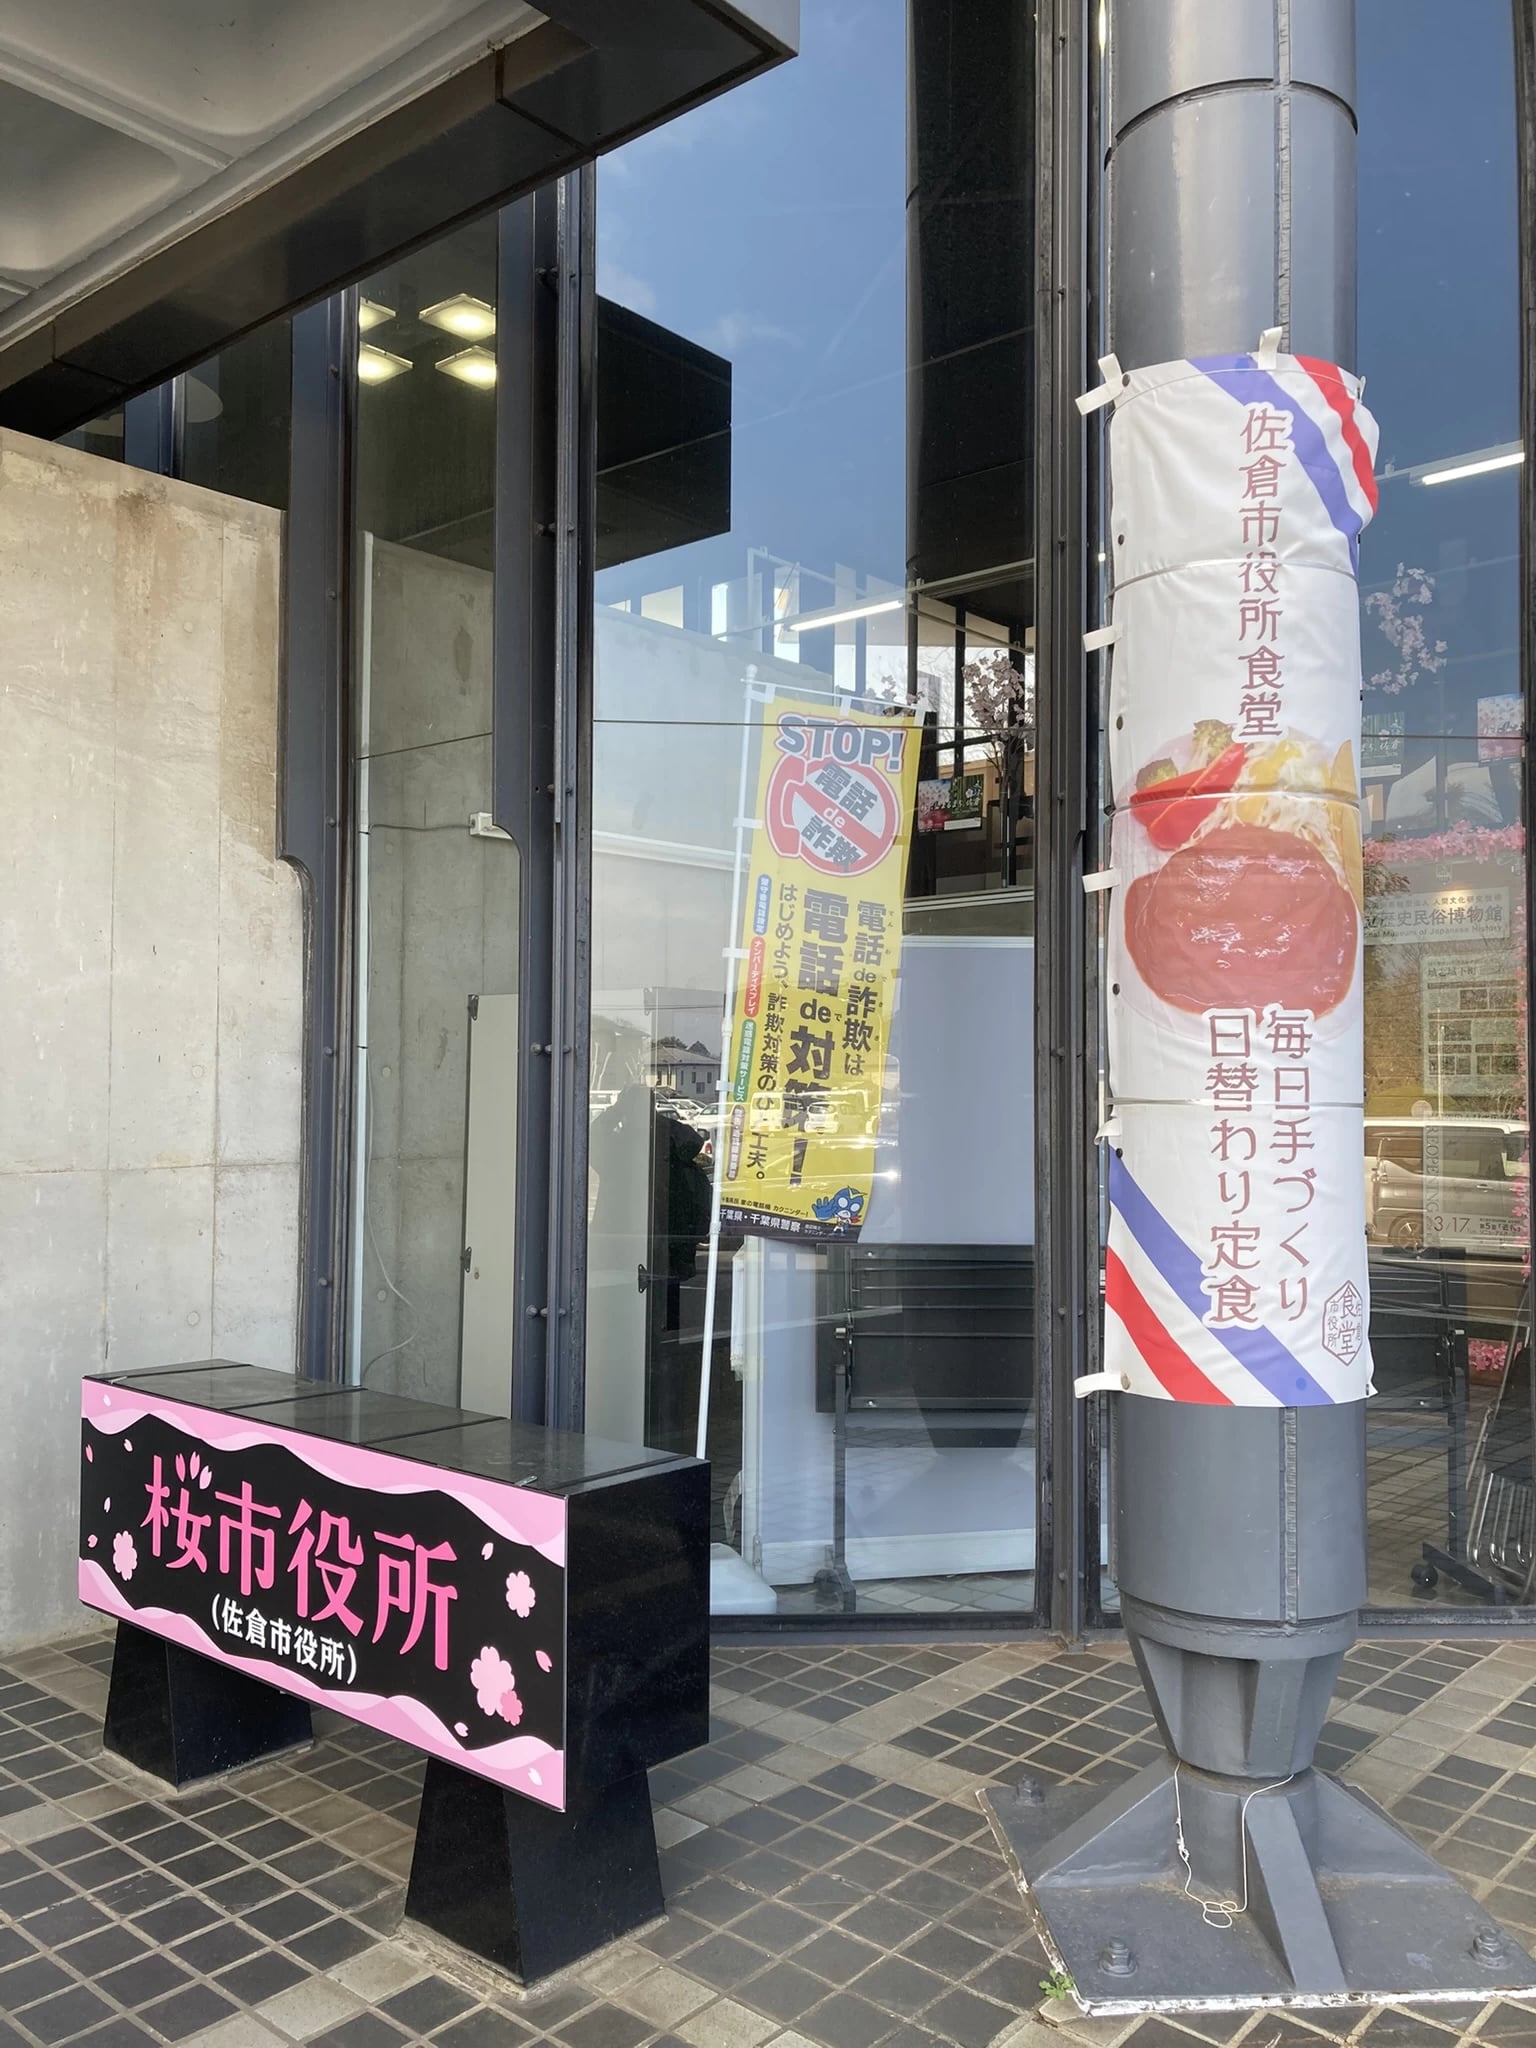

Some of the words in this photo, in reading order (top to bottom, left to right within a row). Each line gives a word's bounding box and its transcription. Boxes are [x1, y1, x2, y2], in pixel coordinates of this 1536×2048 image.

[1238, 408, 1287, 737] 佐倉市役所食堂
[776, 714, 905, 772] STOP!
[814, 761, 878, 821] 電話
[823, 805, 846, 829] de
[801, 815, 862, 873] 詐欺
[748, 940, 762, 1014] ナンバーディスプレイ
[842, 900, 887, 1076] 電話de詐欺は
[747, 882, 798, 1180] はじめよう、詐欺対策のひ工夫。
[1205, 1013, 1261, 1323] 日替わり定食
[1264, 1009, 1317, 1321] 毎日手づくり
[720, 1208, 800, 1232] 千葉県・千葉県警察
[1433, 1215, 1471, 1232] 3/17
[1328, 1299, 1339, 1347] 市役所
[1337, 1285, 1357, 1356] 食堂
[140, 1452, 458, 1671] 桜市役所
[211, 1593, 358, 1685] (佐倉市役所)
